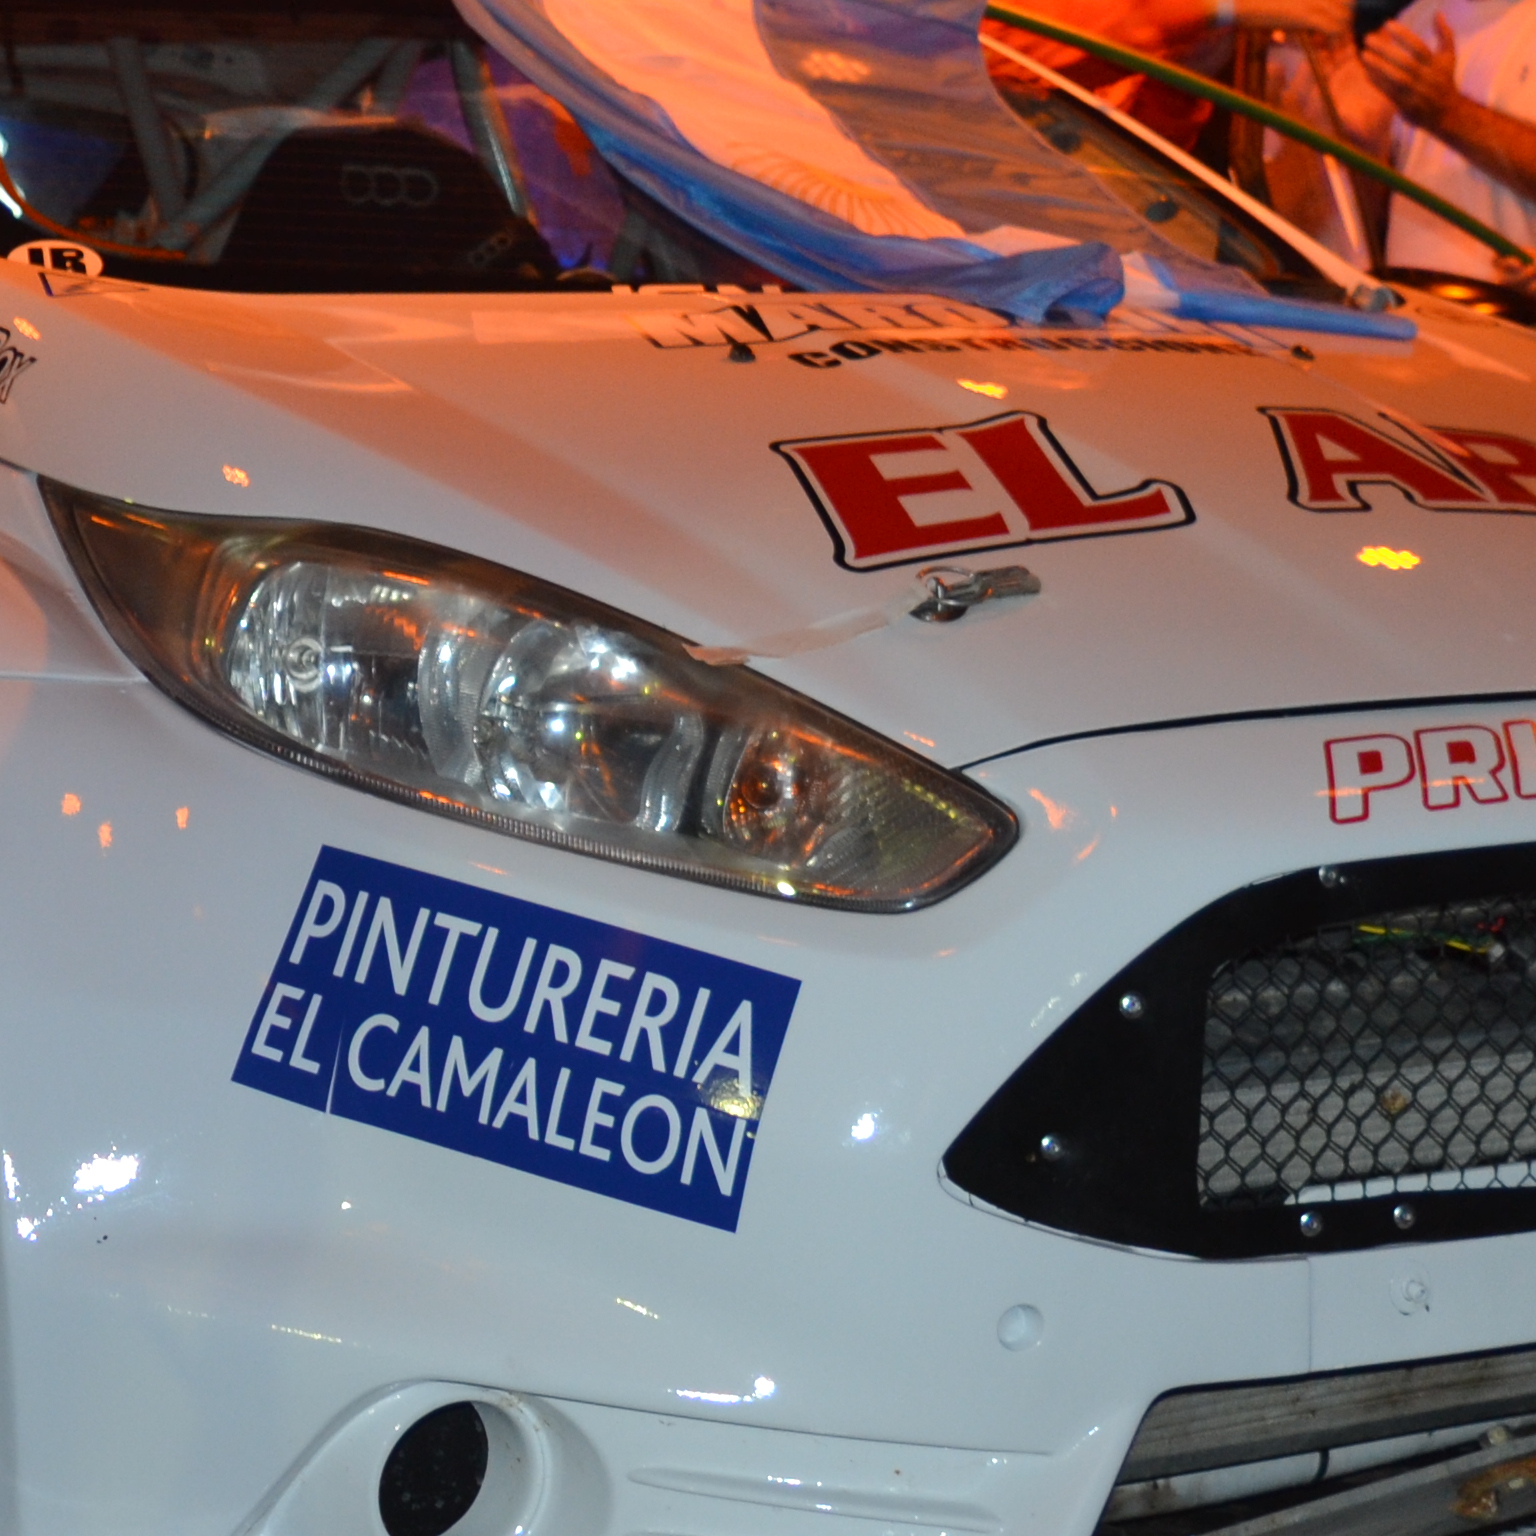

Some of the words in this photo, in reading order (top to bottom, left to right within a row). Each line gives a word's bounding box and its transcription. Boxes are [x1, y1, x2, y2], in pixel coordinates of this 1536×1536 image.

[768, 409, 1197, 573] EL
[251, 981, 322, 1074] EL
[347, 1013, 747, 1196] CAMALEON
[289, 879, 753, 1097] PINTURERIA
